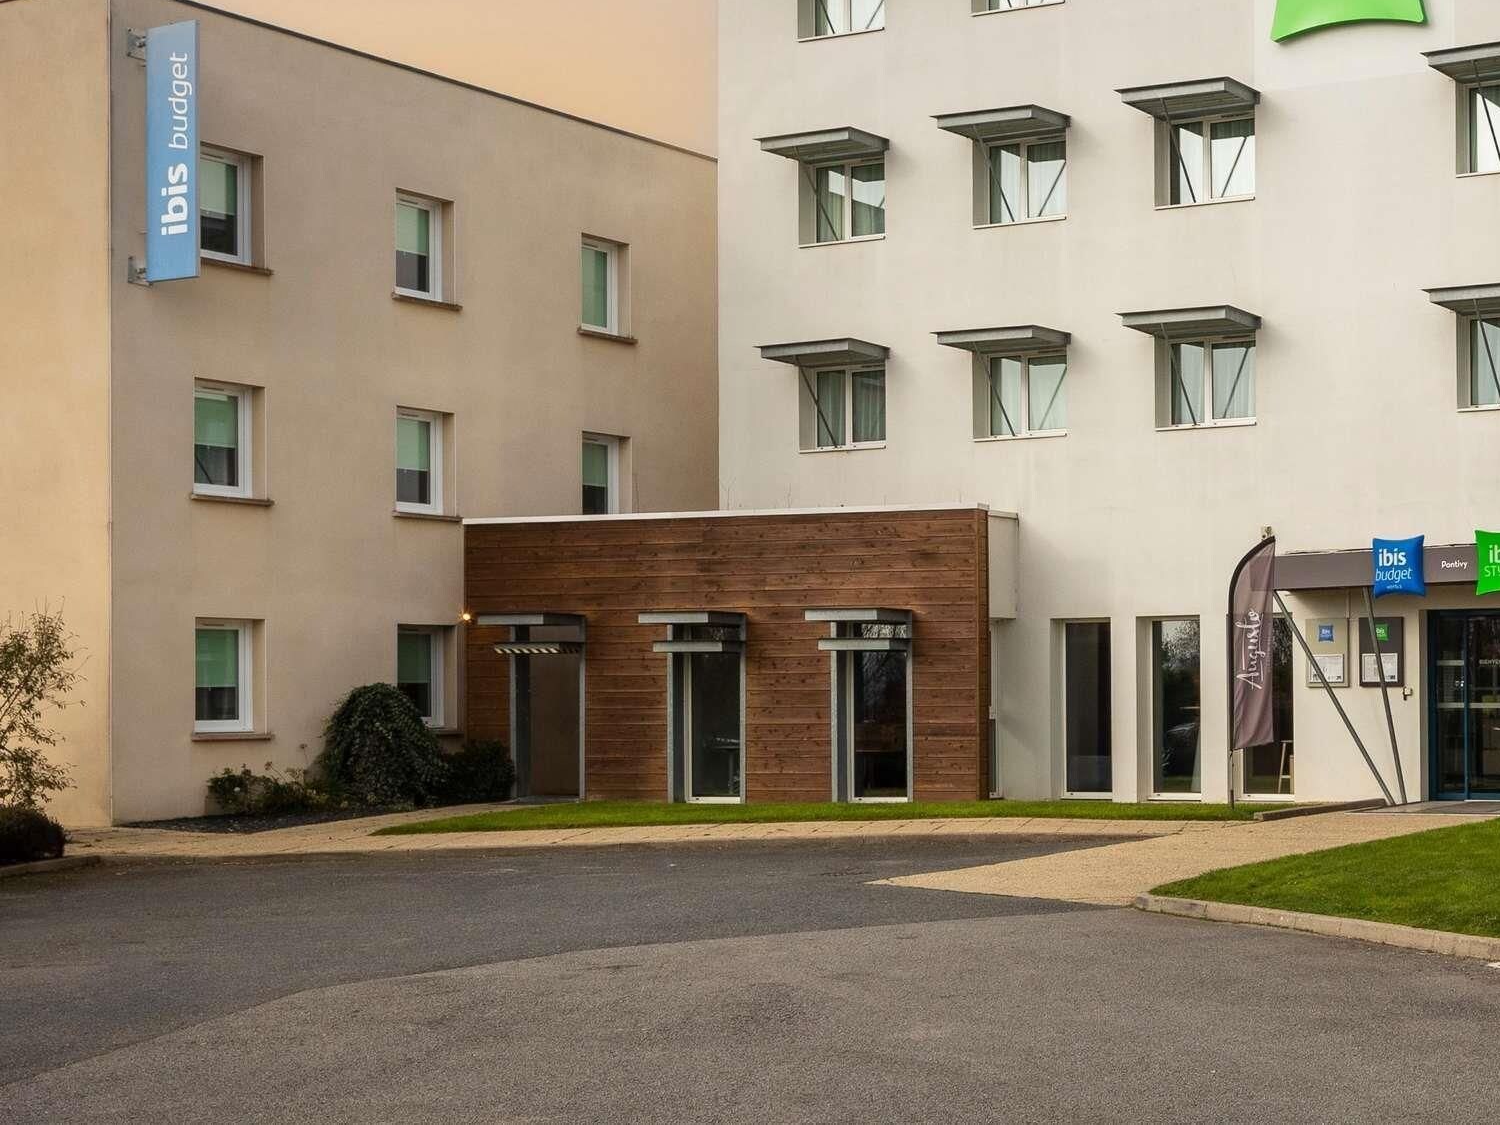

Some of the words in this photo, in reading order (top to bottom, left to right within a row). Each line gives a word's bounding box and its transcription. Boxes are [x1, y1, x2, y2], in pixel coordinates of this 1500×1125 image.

[168, 52, 192, 150] budget
[161, 162, 188, 236] ibis
[1375, 567, 1413, 584] budget
[1378, 547, 1407, 567] ibis
[1441, 559, 1469, 570] Pontivy
[1235, 608, 1267, 690] Augusto
